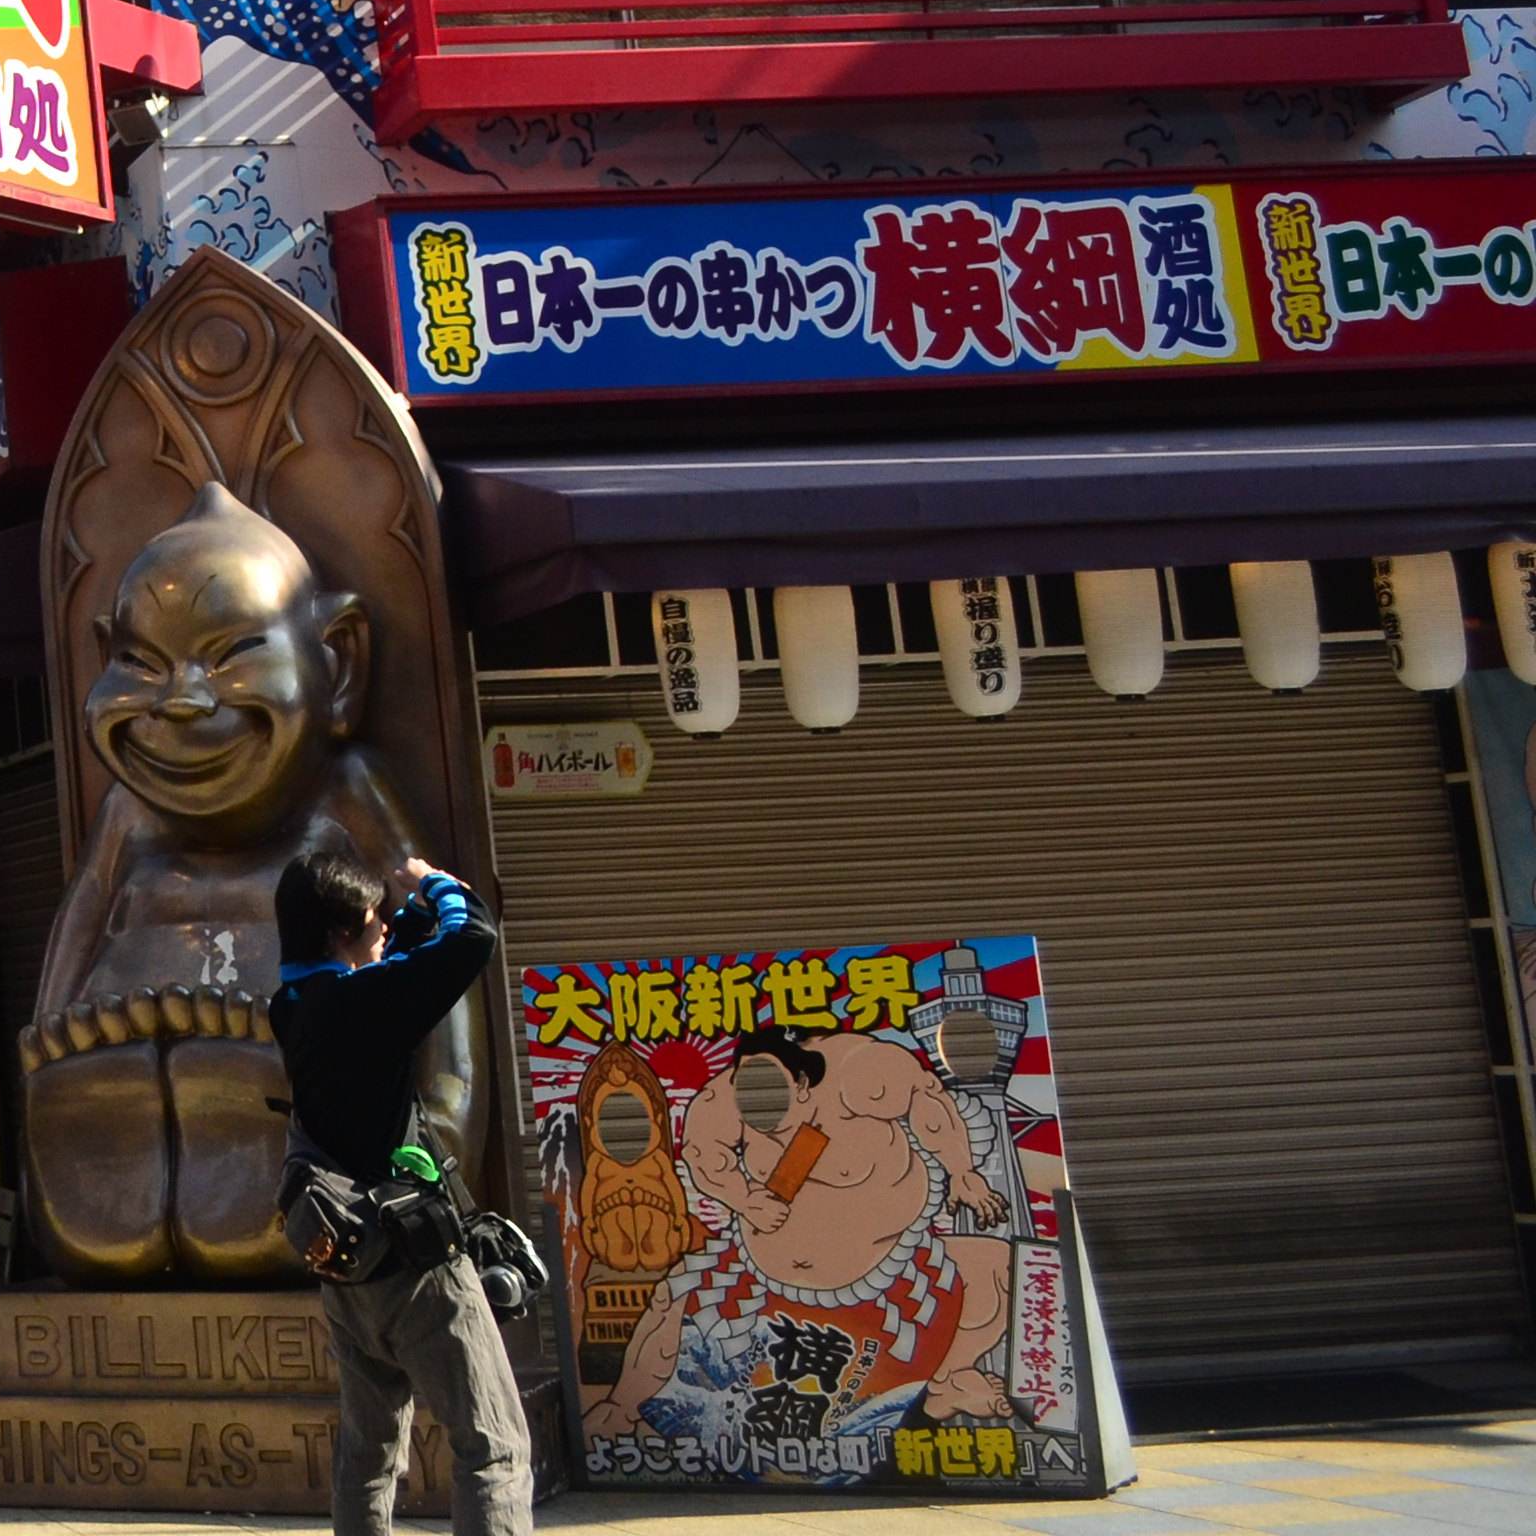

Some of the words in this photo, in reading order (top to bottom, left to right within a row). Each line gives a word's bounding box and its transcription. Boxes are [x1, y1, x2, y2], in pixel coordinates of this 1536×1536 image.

[415, 227, 482, 378] 新世界
[1138, 203, 1228, 350] 酒処
[1263, 199, 1331, 344] 新世界
[1330, 224, 1536, 314] 日本一の
[517, 750, 615, 775] 角ハイボール
[534, 954, 920, 1045] 大阪新世界
[741, 1310, 856, 1442] 横綱
[828, 1338, 880, 1433] 日本一の串かつ
